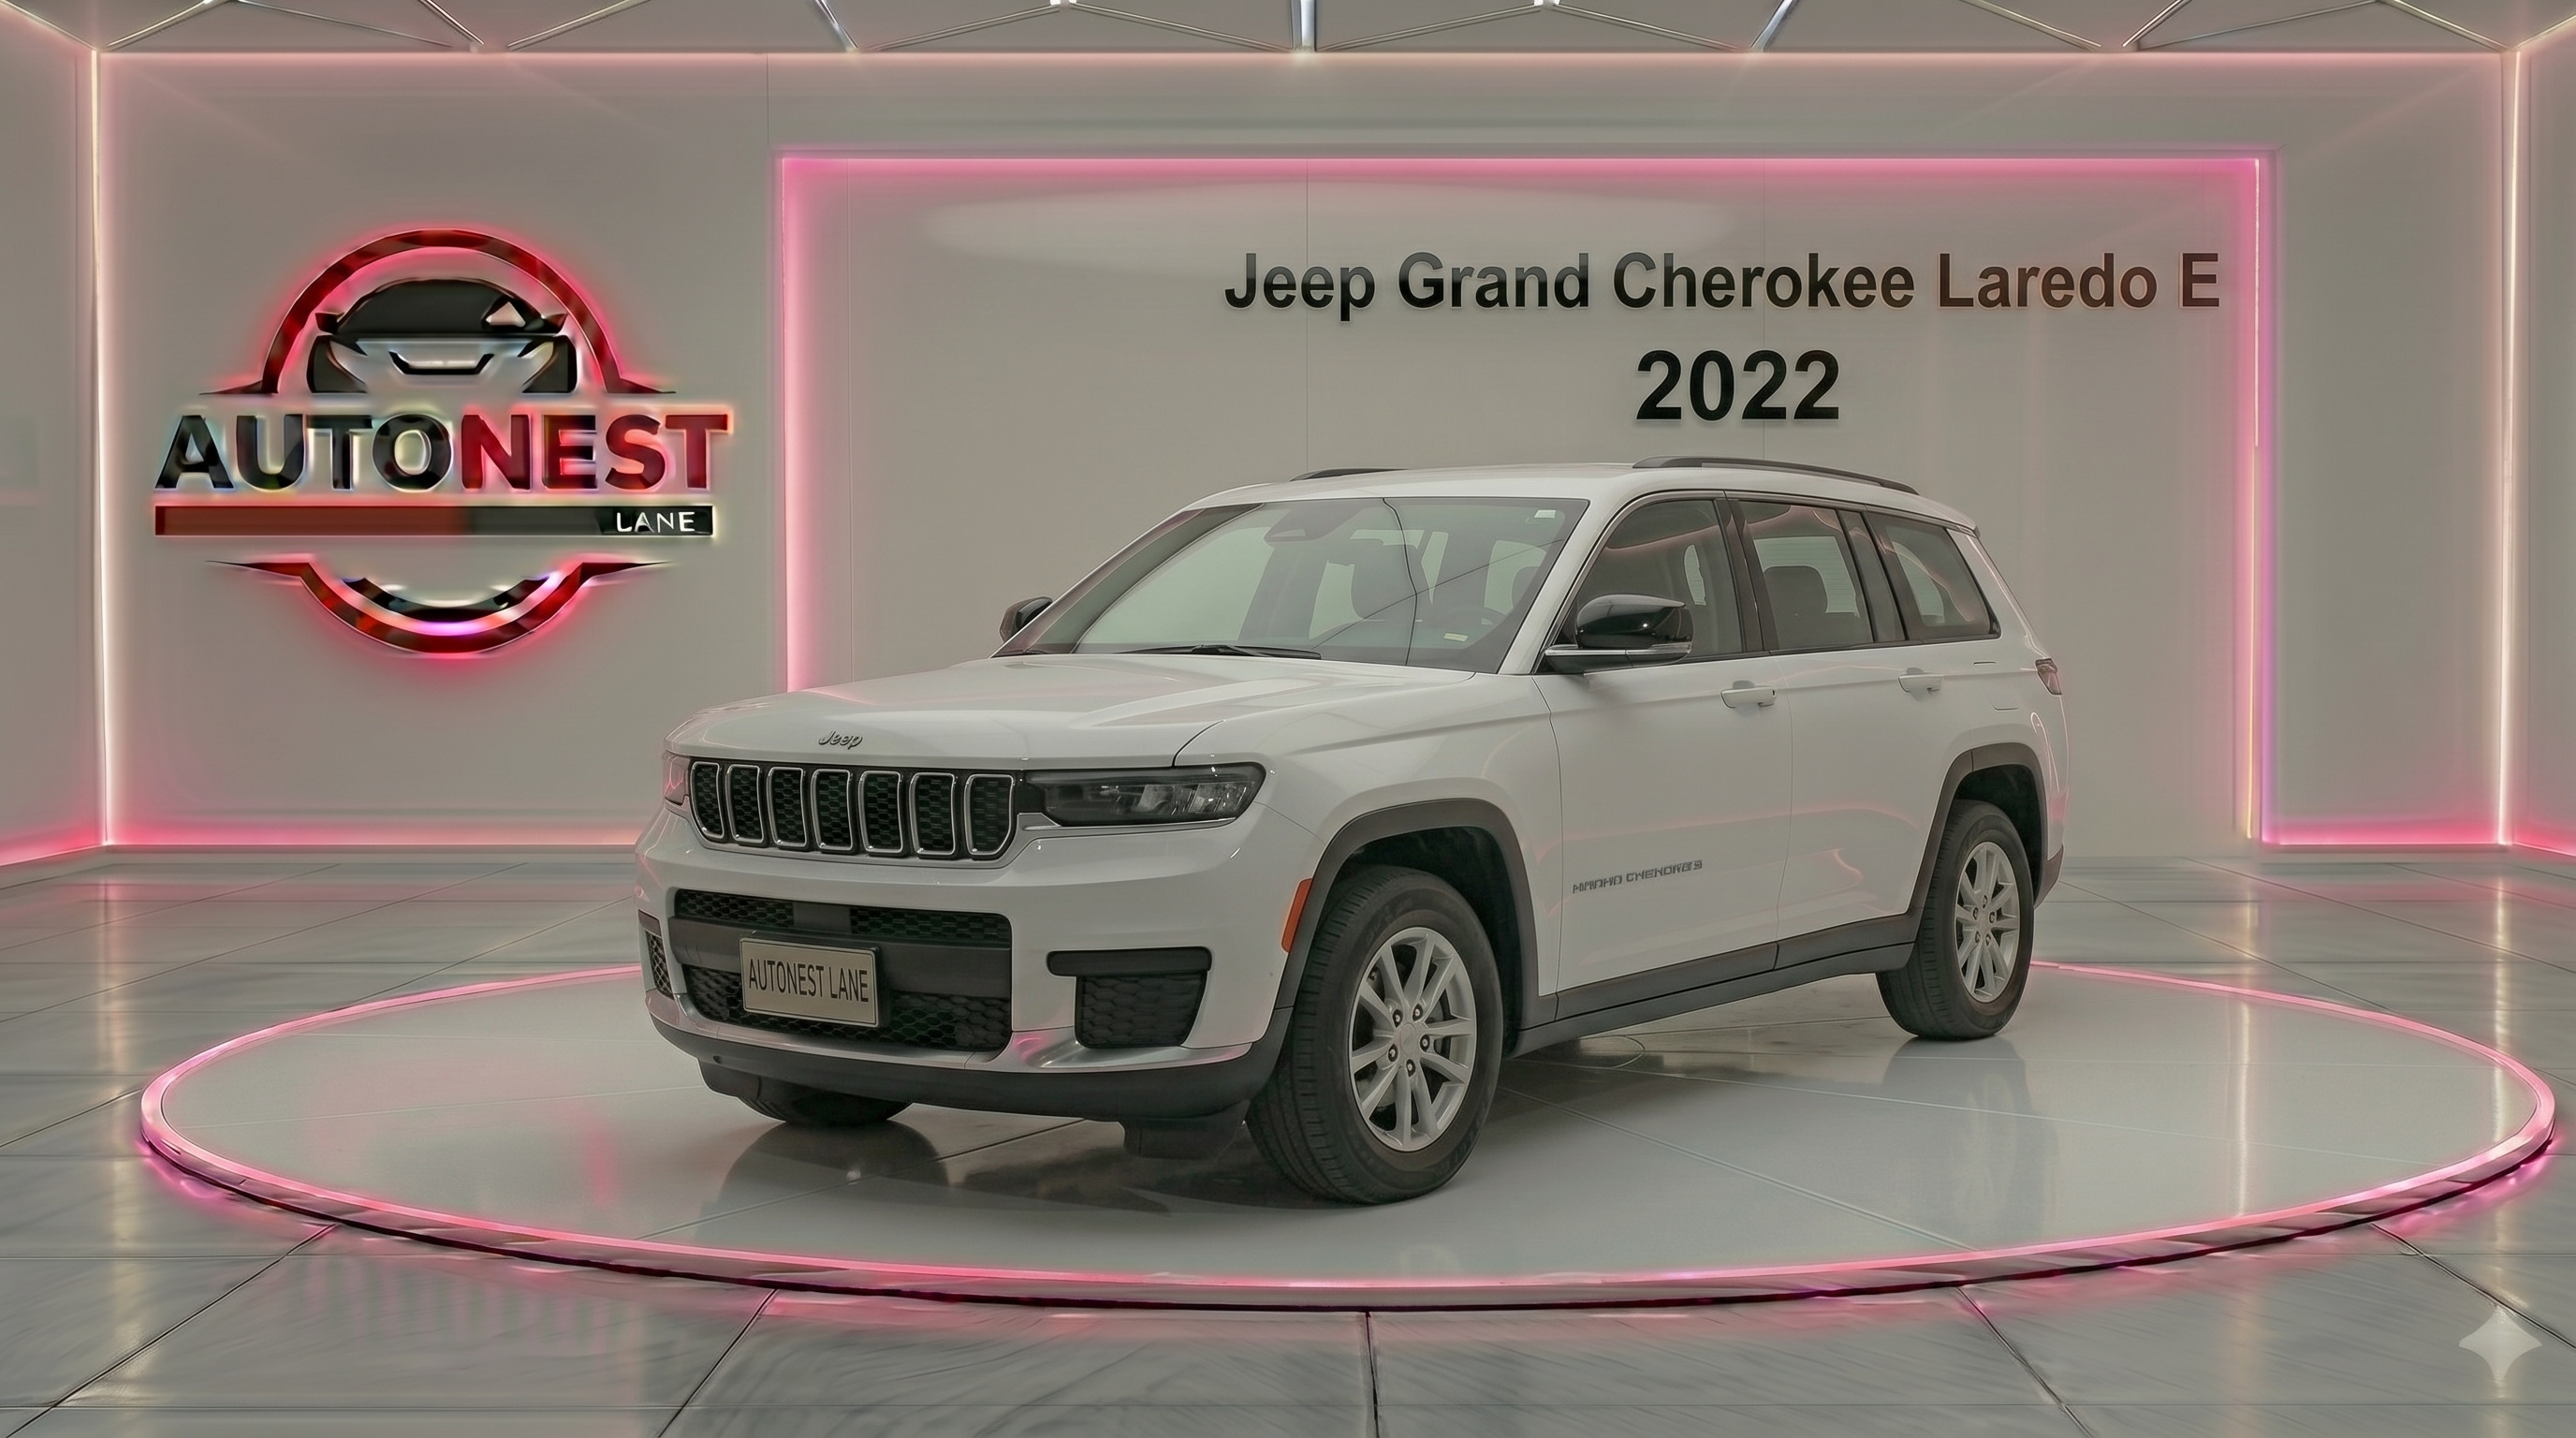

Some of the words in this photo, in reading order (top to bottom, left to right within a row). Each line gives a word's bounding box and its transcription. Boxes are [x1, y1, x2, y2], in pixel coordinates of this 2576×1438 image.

[1224, 253, 1376, 322] Jeep
[1398, 252, 1589, 309] Grand
[1613, 252, 1915, 309] Cherokee
[1939, 253, 2158, 309] Laredo
[2182, 253, 2219, 307] E
[1636, 349, 1839, 421] 2022
[154, 413, 730, 491] AUTONEST
[615, 511, 696, 533] LANE
[818, 730, 863, 750] Jeep
[749, 958, 824, 998] AUTONEST
[828, 966, 869, 1003] LANE
